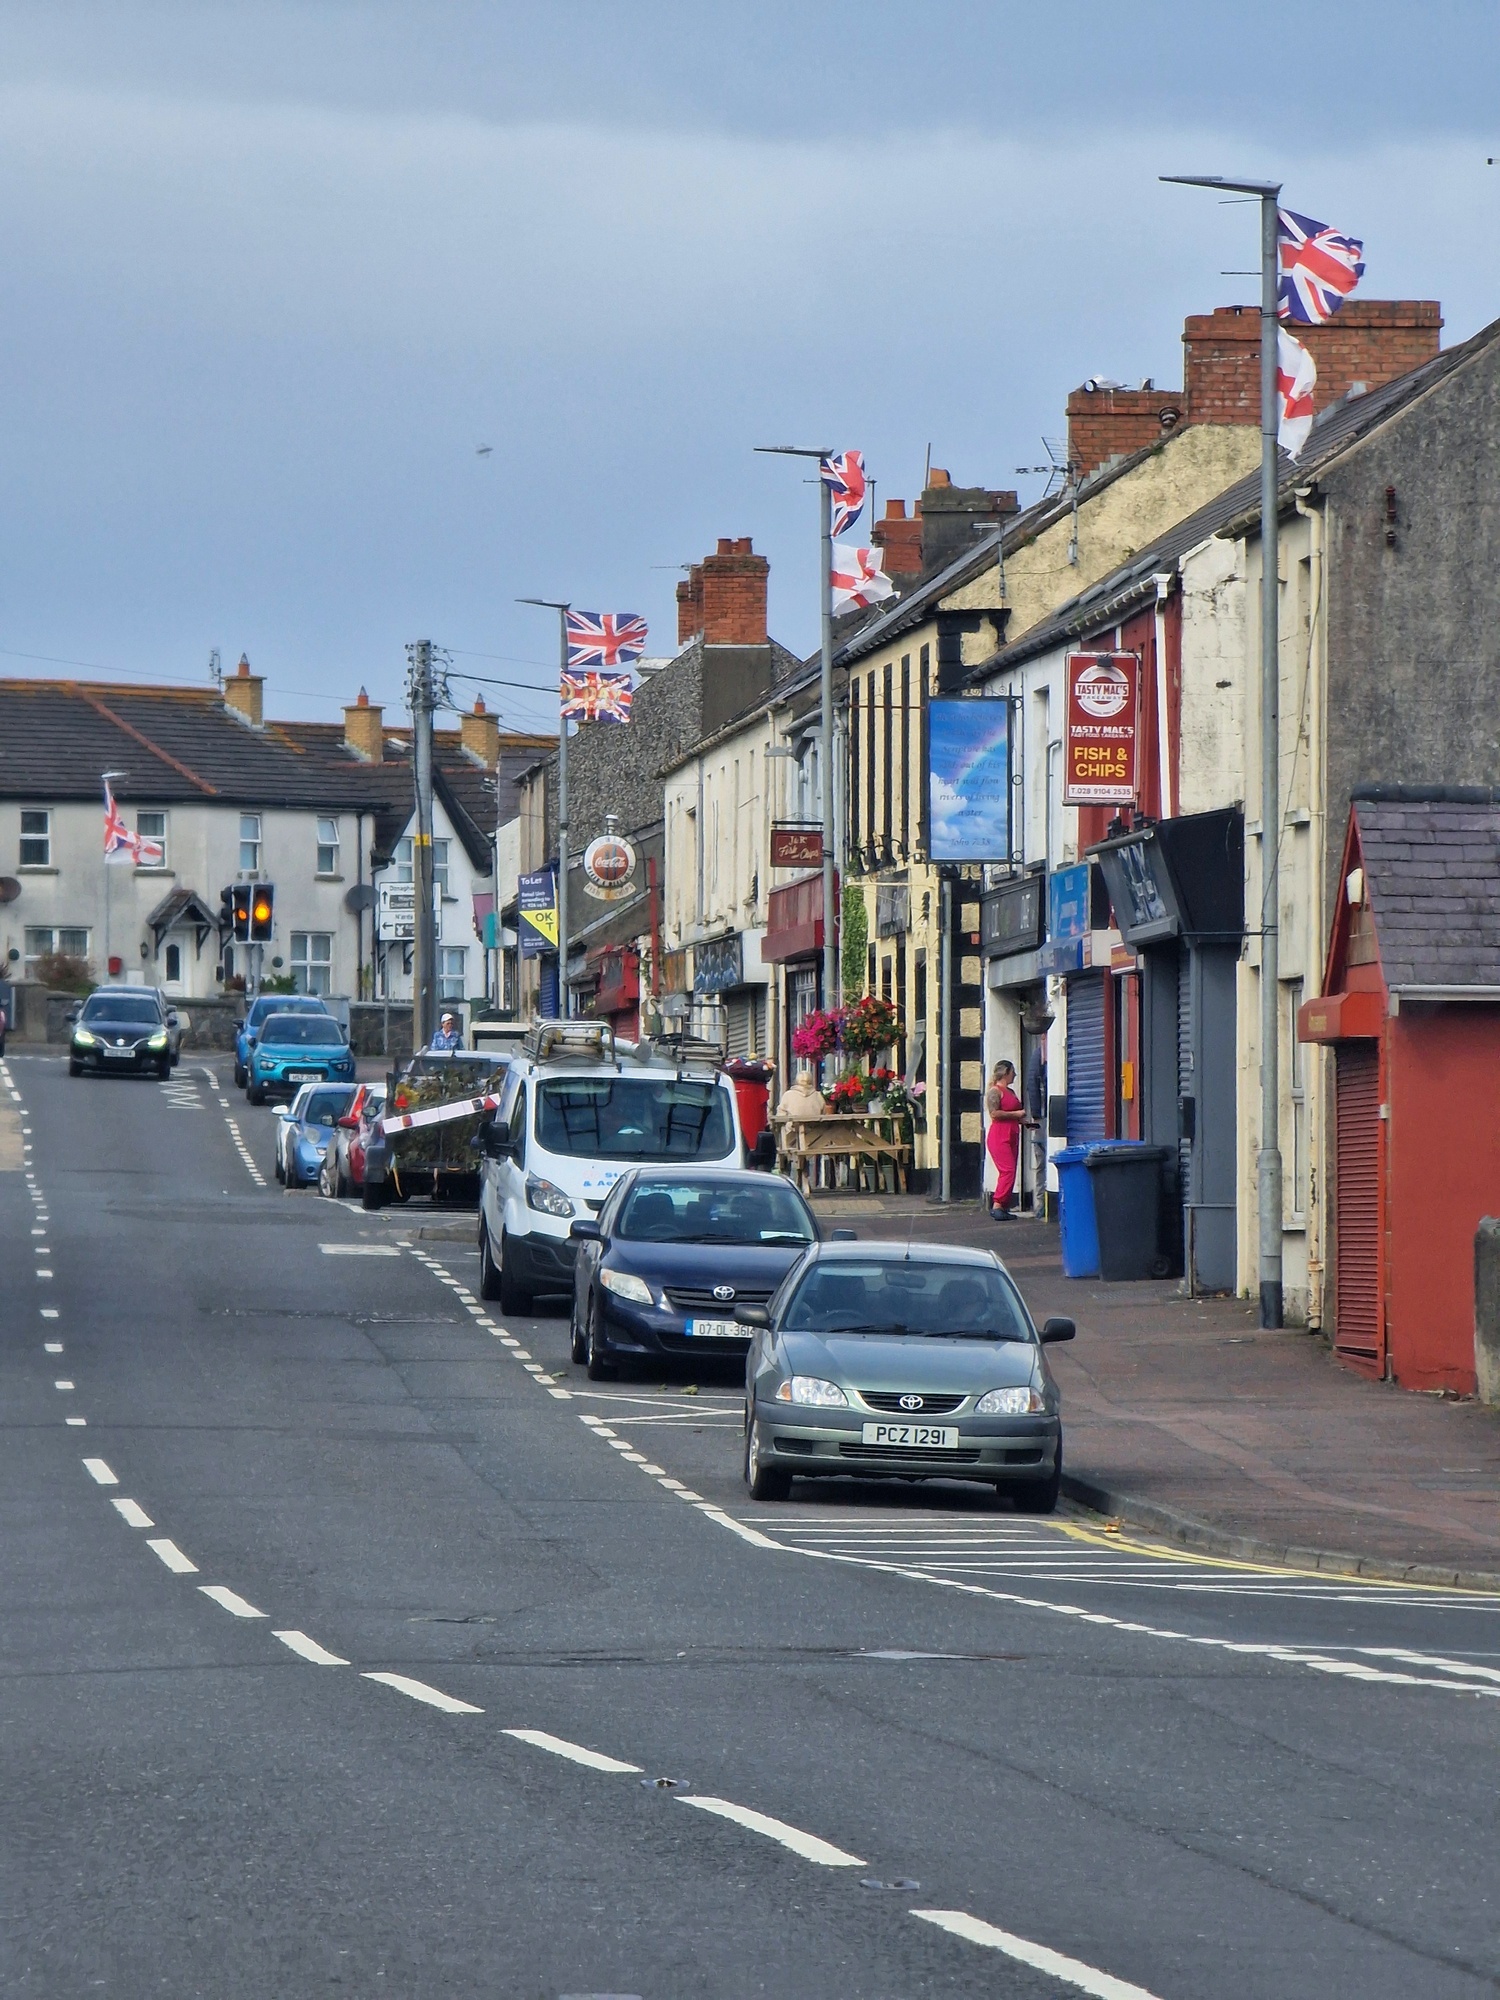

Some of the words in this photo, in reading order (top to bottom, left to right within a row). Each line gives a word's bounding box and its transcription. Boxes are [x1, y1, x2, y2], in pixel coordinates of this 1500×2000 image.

[1077, 684, 1102, 695] TASTY
[1103, 684, 1128, 695] MAC'S
[1071, 725, 1101, 734] TASTY
[1102, 726, 1134, 734] MAC'S
[1074, 747, 1111, 761] FISH
[1116, 747, 1128, 761] &
[1075, 763, 1126, 778] CHIPS
[1094, 787, 1111, 795] 9104
[1113, 788, 1131, 796] 2535
[957, 809, 983, 817] water
[530, 877, 543, 885] Let
[535, 912, 553, 922] OK
[545, 922, 554, 931] T
[876, 1426, 909, 1443] PCZ
[914, 1428, 946, 1445] 1291
